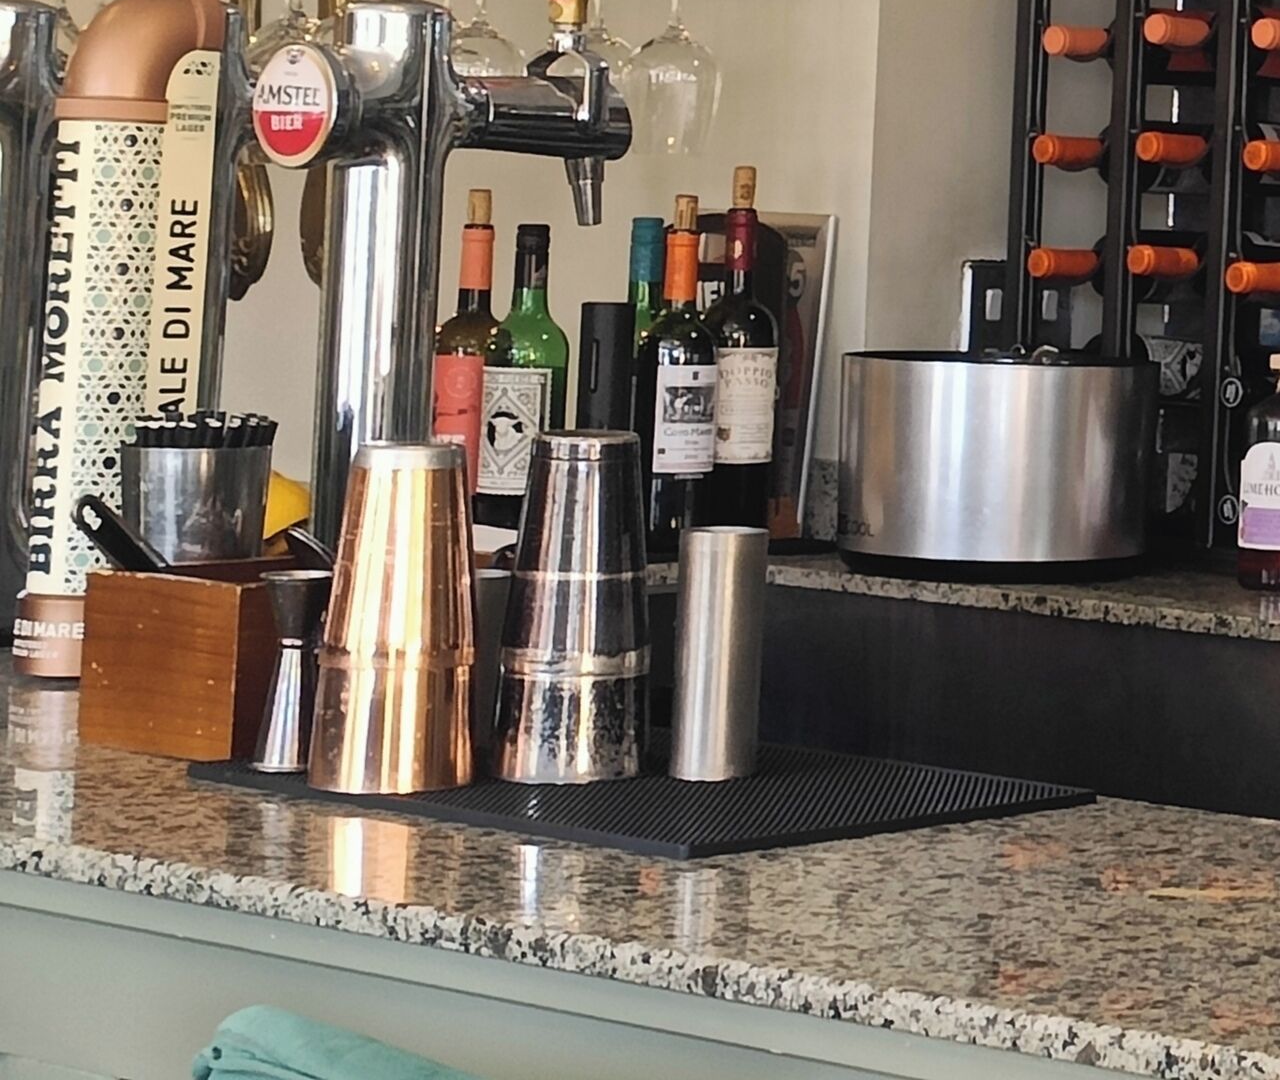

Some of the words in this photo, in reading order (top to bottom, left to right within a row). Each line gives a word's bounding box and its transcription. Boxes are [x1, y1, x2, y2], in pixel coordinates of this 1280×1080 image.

[257, 84, 321, 108] AMSTEL
[170, 112, 211, 121] PREMIUM
[175, 124, 206, 133] LAGER
[270, 115, 303, 131] BIER
[166, 198, 199, 291] MARE
[42, 136, 81, 383] MORETTI
[162, 307, 192, 341] DI
[29, 406, 63, 576] BIRRA
[34, 621, 85, 639] MARE
